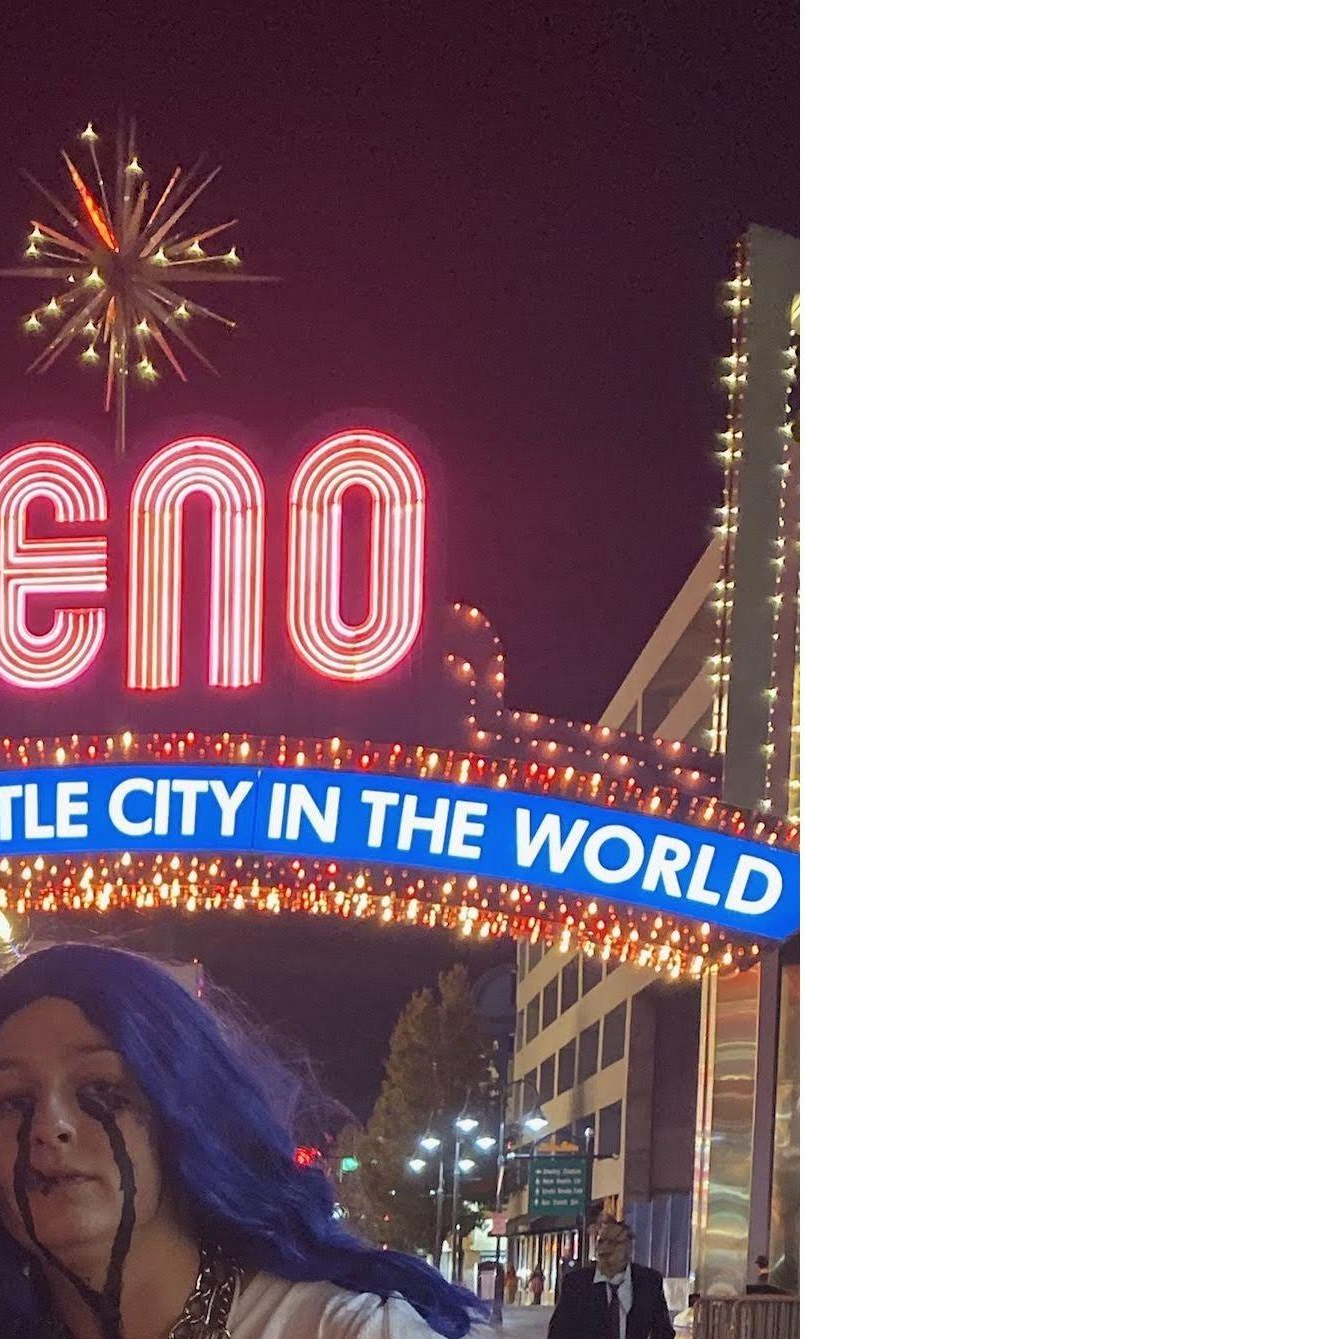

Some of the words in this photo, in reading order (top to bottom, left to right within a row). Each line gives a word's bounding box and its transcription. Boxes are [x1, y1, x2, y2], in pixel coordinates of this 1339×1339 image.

[108, 777, 254, 837] CITY
[267, 782, 341, 843] IN
[361, 789, 488, 860] THE
[514, 807, 784, 916] WORLD
